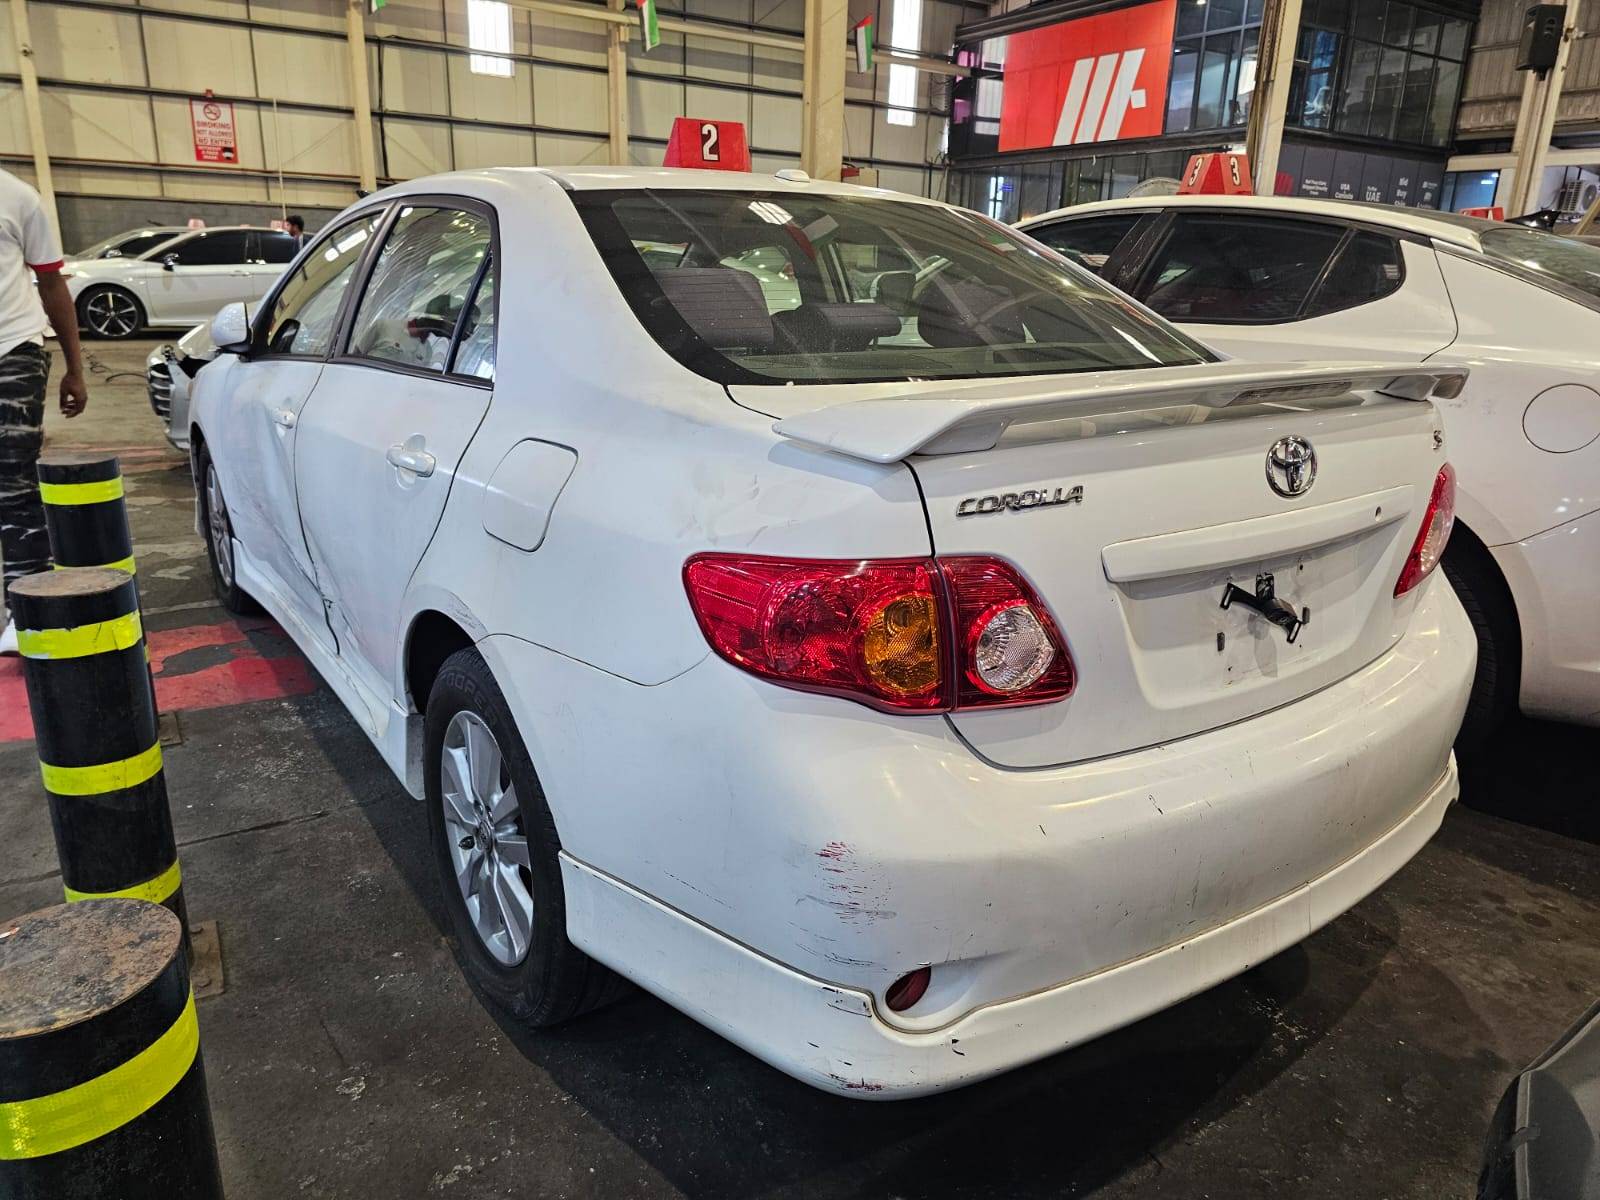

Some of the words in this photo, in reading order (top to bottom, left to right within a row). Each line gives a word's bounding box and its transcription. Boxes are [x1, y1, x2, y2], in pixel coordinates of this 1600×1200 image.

[196, 121, 231, 129] SMOKING
[210, 138, 232, 146] ENTRY
[702, 124, 718, 161] 2
[1188, 157, 1203, 186] 3
[1230, 156, 1241, 186] 3
[1365, 191, 1381, 202] UAE
[1396, 189, 1407, 199] Buy
[1432, 430, 1443, 450] S
[956, 485, 1083, 517] COROLLA
